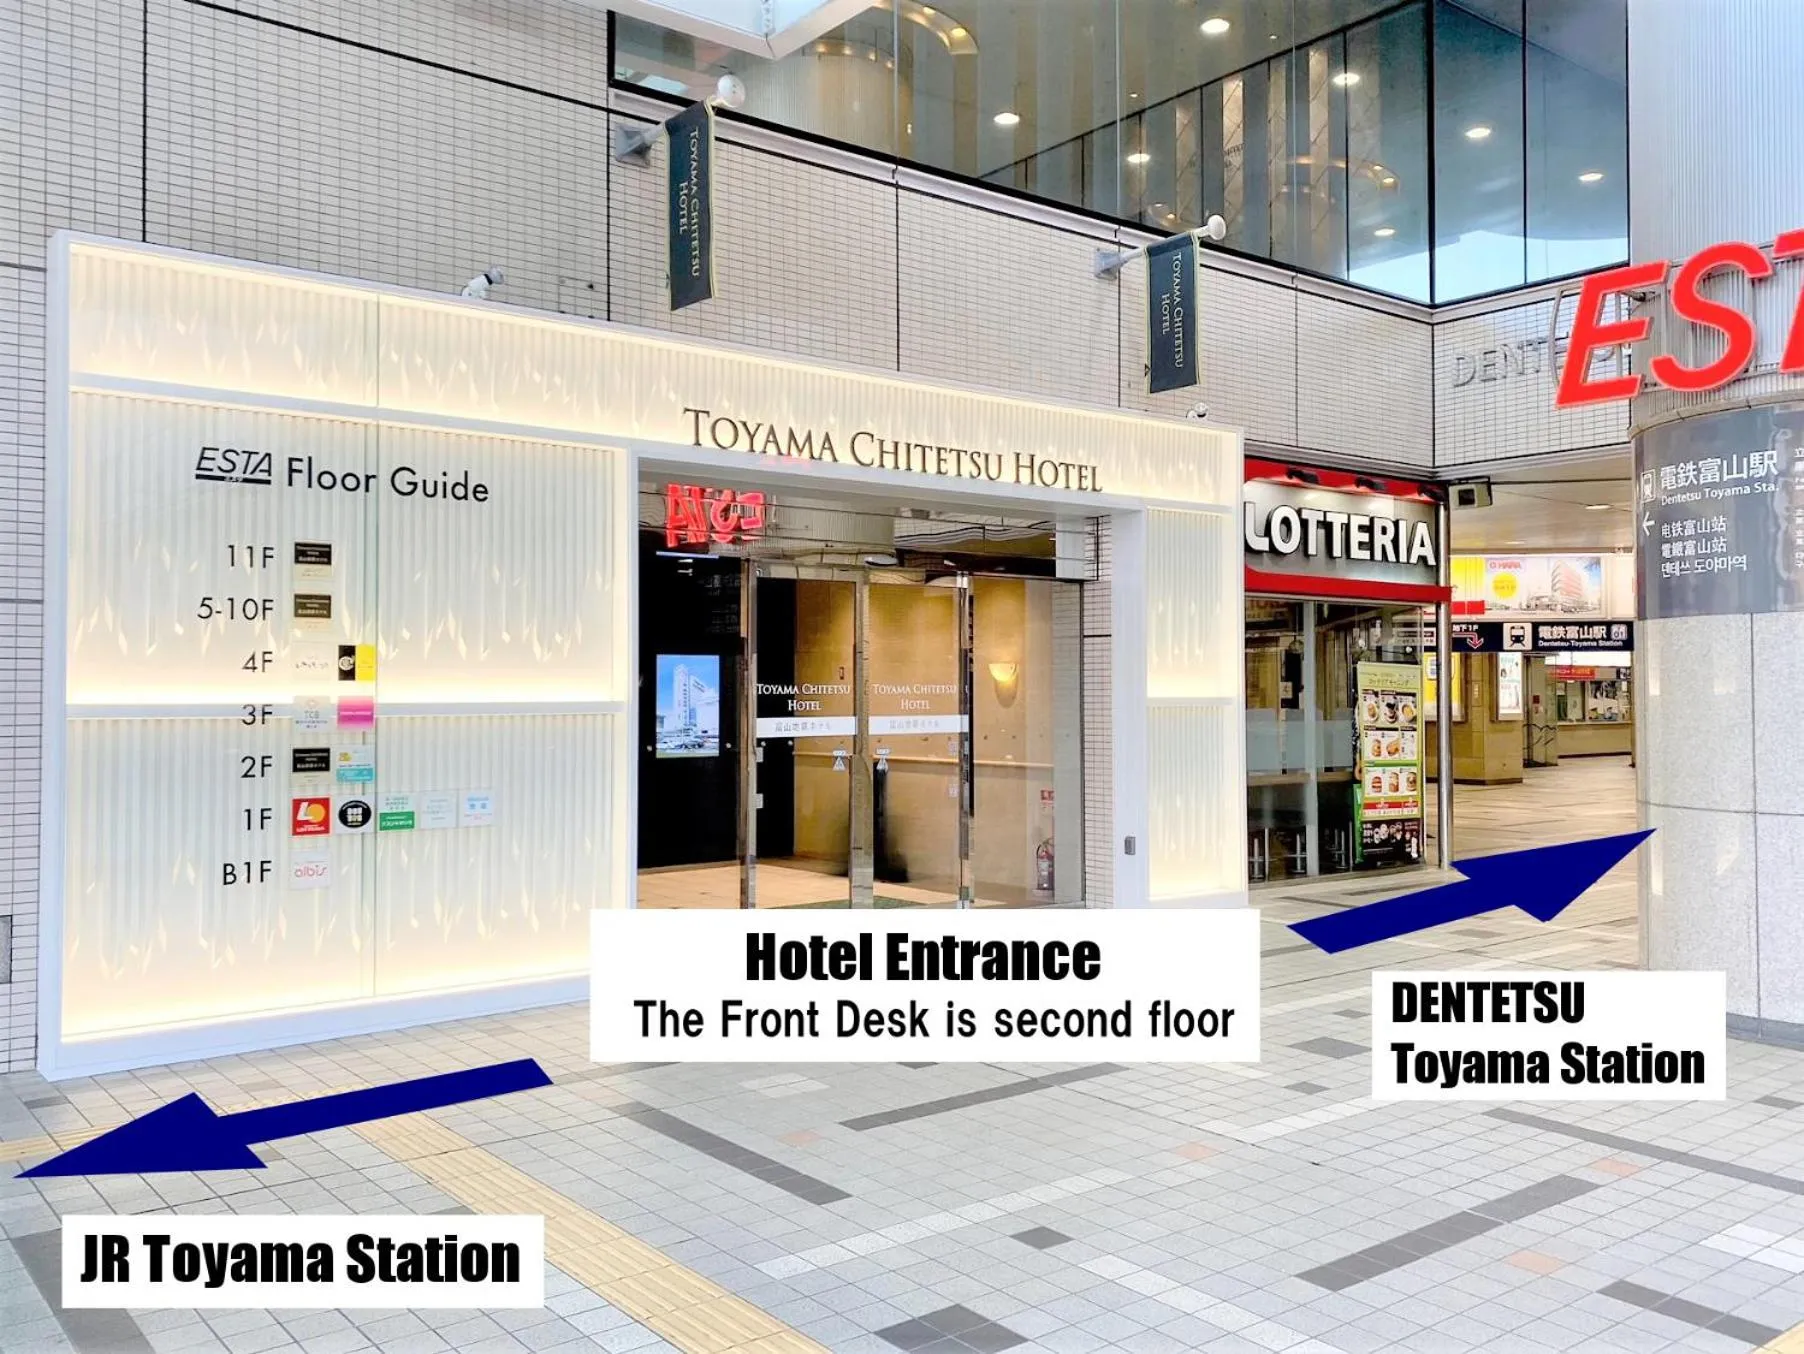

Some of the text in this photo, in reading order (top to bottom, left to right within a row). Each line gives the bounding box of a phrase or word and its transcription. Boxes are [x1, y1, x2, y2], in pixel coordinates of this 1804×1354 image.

[679, 182, 689, 235] HOTEL
[1161, 293, 1170, 336] HOTEL
[1555, 228, 1804, 409] ES
[683, 407, 1103, 493] TOYAMA CHITETSU HOTEL
[196, 447, 489, 502] ESTA Floor Guide
[1660, 451, 1779, 491] 電鉄富山駅
[1661, 481, 1780, 506] Dentetsu Toyama Sta.
[1244, 501, 1437, 566] LOTTERIA
[228, 545, 274, 568] 11F
[197, 597, 274, 620] 5-10F
[1538, 625, 1607, 640] 電鉄富山駅
[242, 651, 273, 673] 4F
[757, 683, 850, 695] TOYAMA CHITETSU
[872, 683, 959, 695] TOYAMA CHITETSU
[241, 703, 273, 726] 3F
[788, 700, 822, 711] HOTEL
[901, 699, 931, 710] HOTEL
[240, 755, 272, 778] 2F
[244, 807, 272, 831] 1F
[223, 860, 272, 885] B1F
